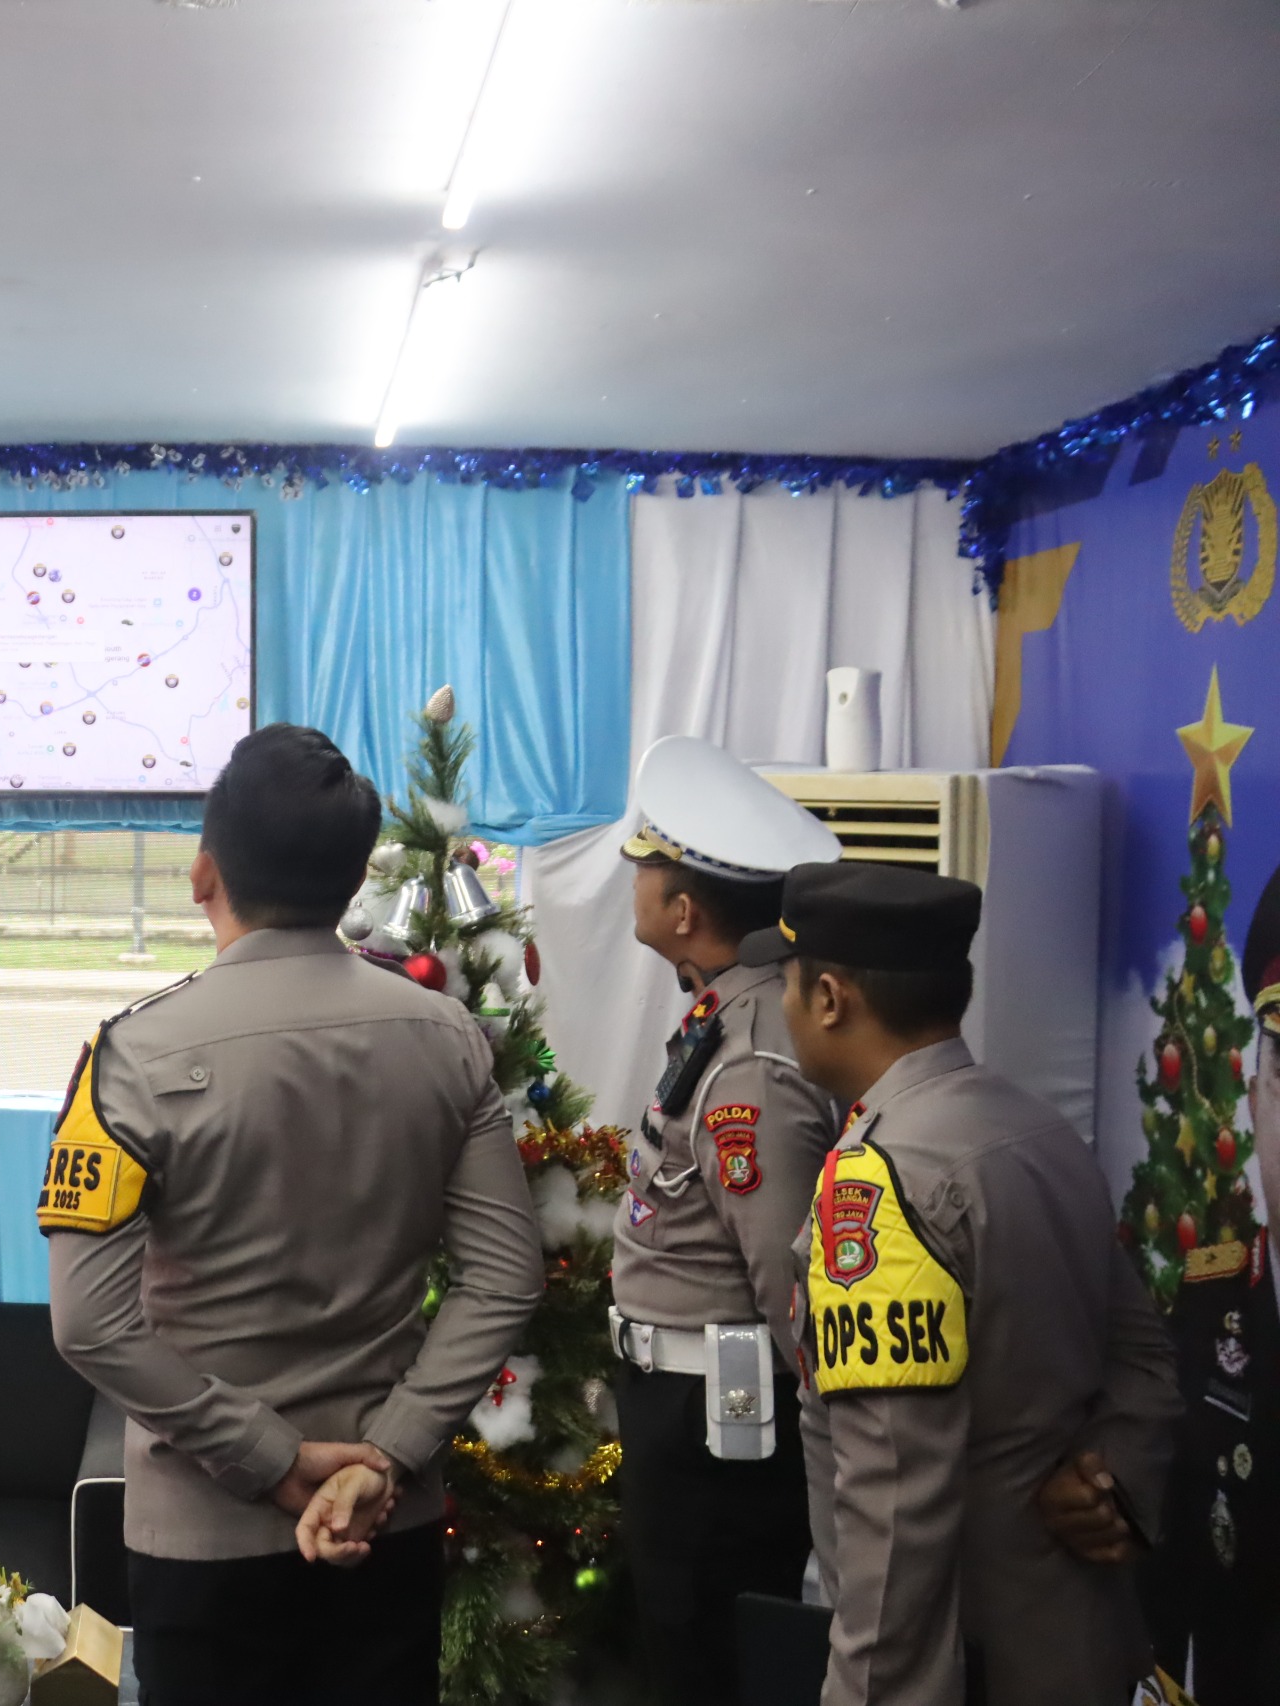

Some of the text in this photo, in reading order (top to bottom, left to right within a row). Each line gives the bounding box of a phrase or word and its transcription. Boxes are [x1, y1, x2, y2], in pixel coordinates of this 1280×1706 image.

[706, 1106, 752, 1126] POLDA
[53, 1189, 81, 1210] 2025
[835, 1187, 863, 1197] LSEK
[846, 1210, 864, 1219] JAYA
[823, 1301, 879, 1369] OPS
[886, 1300, 950, 1365] SEK
